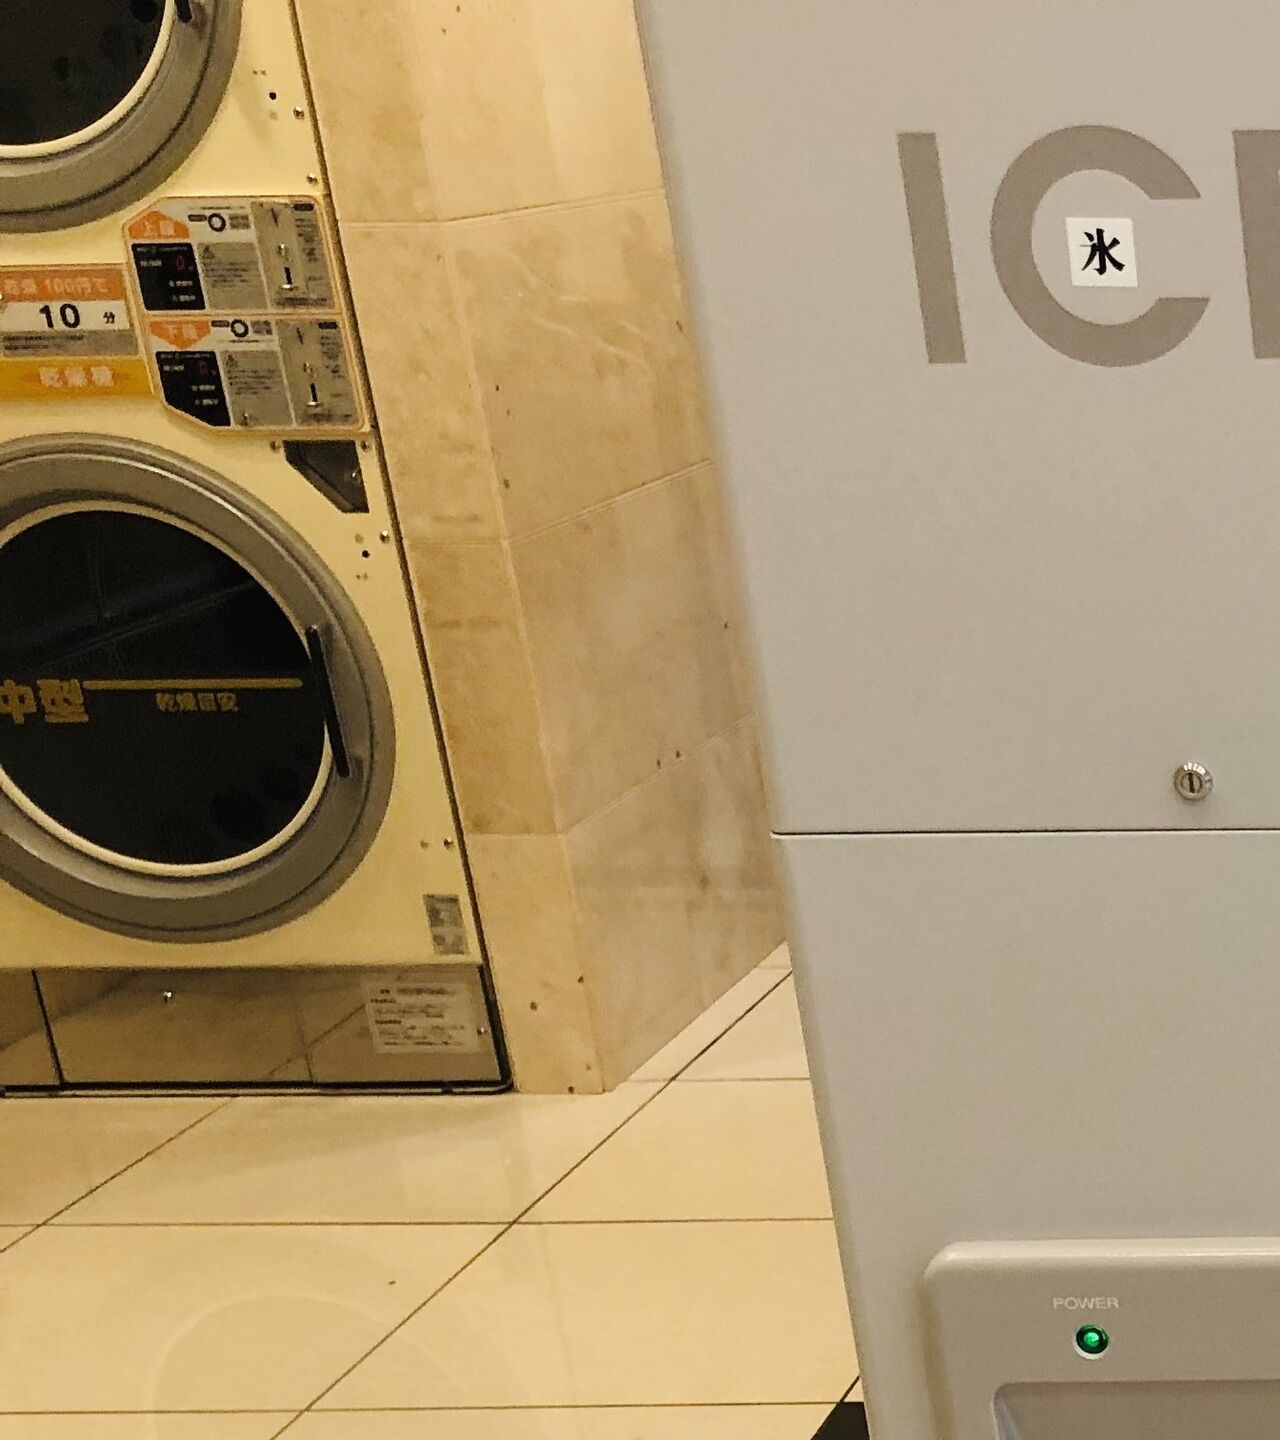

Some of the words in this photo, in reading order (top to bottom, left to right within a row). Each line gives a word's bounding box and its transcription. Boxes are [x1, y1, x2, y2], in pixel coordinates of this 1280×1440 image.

[1080, 228, 1126, 276] 氷
[38, 303, 81, 329] 10
[1052, 1296, 1120, 1310] POWER
